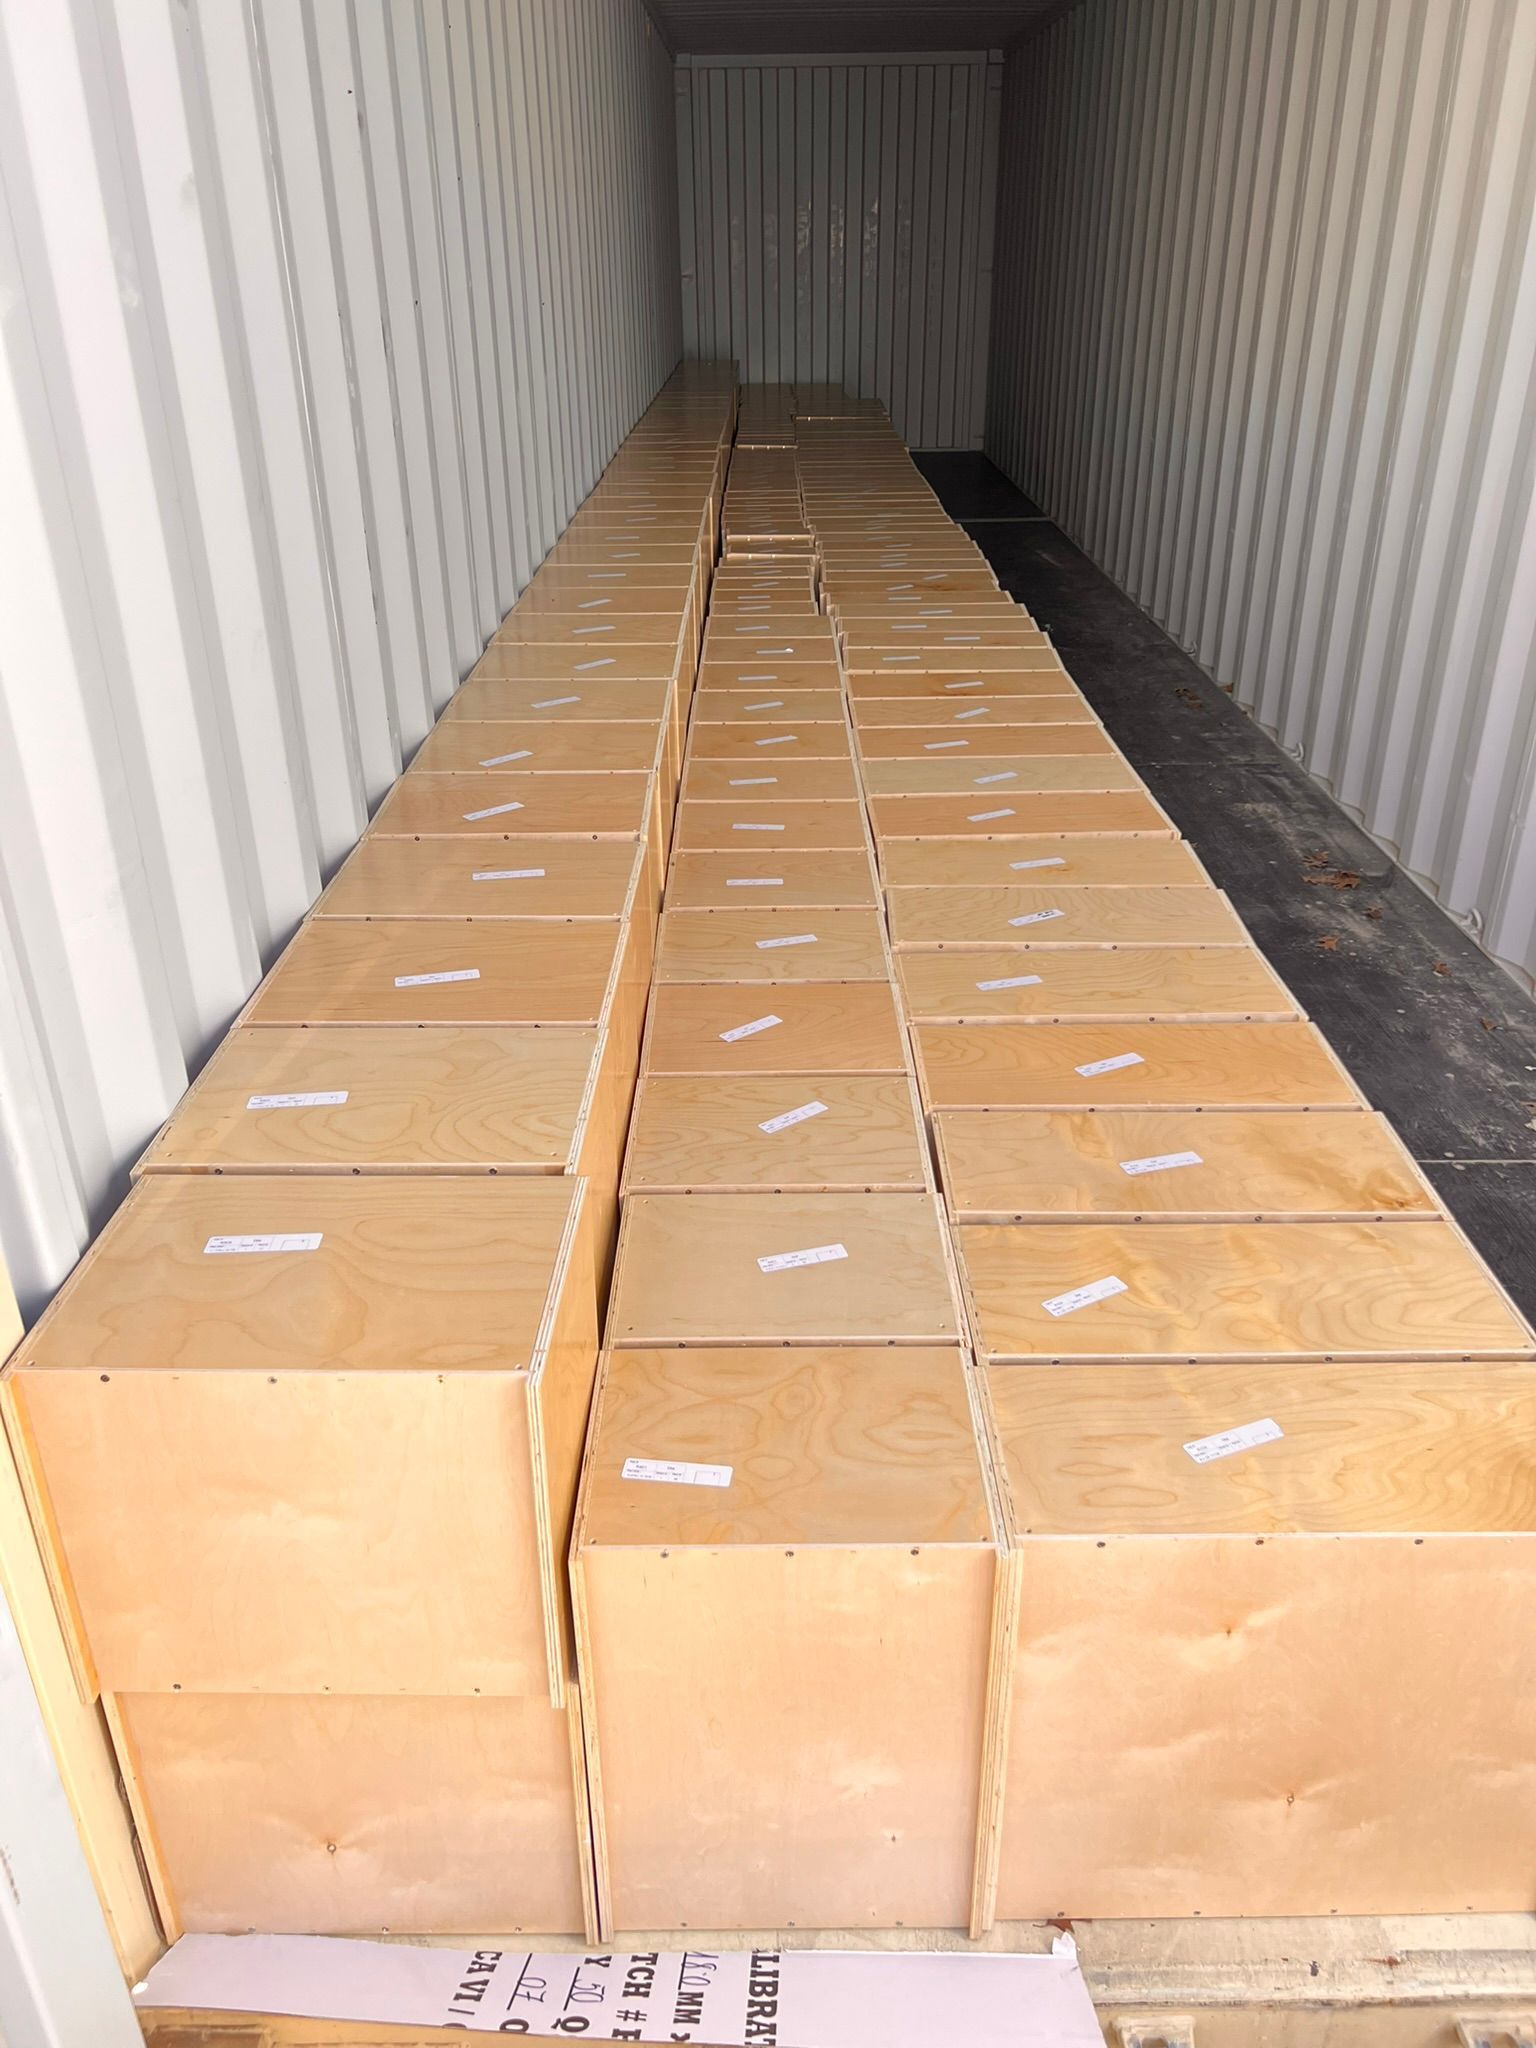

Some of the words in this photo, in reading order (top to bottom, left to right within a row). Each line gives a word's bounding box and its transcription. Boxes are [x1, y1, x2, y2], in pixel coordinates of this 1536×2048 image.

[584, 1955, 612, 1968] Y
[622, 1952, 659, 1998] TCH
[515, 1976, 547, 2003] 07
[570, 1978, 606, 2004] 50
[744, 1947, 781, 2047] LIBRA
[616, 2009, 647, 2022] #
[673, 1992, 704, 2024] MM
[551, 2015, 590, 2033] Q
